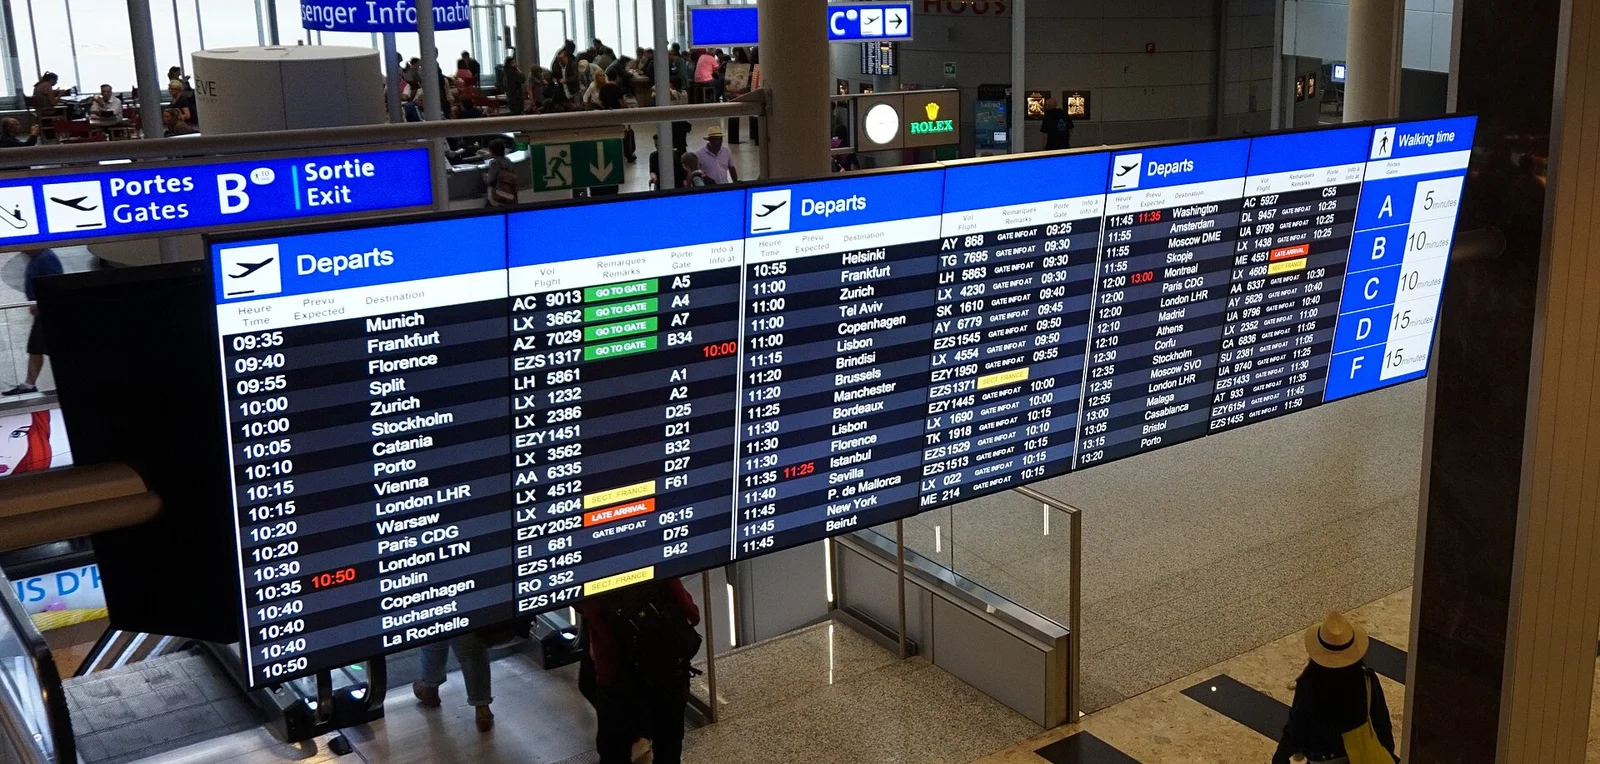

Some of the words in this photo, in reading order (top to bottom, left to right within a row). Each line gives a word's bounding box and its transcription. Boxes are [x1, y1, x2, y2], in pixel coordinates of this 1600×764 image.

[830, 11, 846, 36] C
[910, 120, 954, 134] ROLEX
[1399, 132, 1434, 146] Walking
[1436, 130, 1454, 142] time
[304, 159, 375, 181] Sortie
[1147, 159, 1193, 177] Departs
[110, 174, 194, 197] Portes
[216, 173, 250, 215] B
[307, 185, 352, 206] Exit
[801, 195, 866, 217] Departs
[1110, 214, 1133, 226] 11:45
[1139, 210, 1160, 222] 11:35
[1172, 204, 1218, 218] Washington
[1243, 197, 1256, 208] AC
[1260, 194, 1279, 205] 5927
[1322, 186, 1336, 197] C55
[1378, 195, 1392, 218] A
[1423, 190, 1434, 210] 5
[112, 200, 189, 224] Gates
[843, 232, 884, 242] Destination
[958, 223, 976, 231] Flight
[1106, 245, 1129, 257] 11:55
[1168, 236, 1200, 248] Moscow
[1201, 230, 1221, 243] DME
[1239, 226, 1251, 236] UA
[1255, 222, 1274, 234] 9799
[1316, 213, 1334, 224] 10:25
[754, 261, 786, 276] 10:55
[842, 248, 885, 264] Helsinki
[941, 237, 958, 250] AY
[964, 234, 983, 247] 868
[997, 232, 1013, 240] GATE
[1029, 228, 1037, 236] AT
[1046, 222, 1071, 235] 09:25
[794, 243, 829, 253] Expected
[1371, 236, 1386, 259] B
[1409, 230, 1426, 251] 10
[297, 248, 394, 275] Departs
[596, 258, 646, 268] Remarques
[533, 278, 560, 288] Flight
[602, 268, 640, 278] Remarks
[1401, 270, 1418, 291] 10
[365, 291, 424, 304] Destination
[1364, 277, 1379, 299] C
[238, 306, 271, 314] Heure
[751, 315, 784, 331] 11:00
[839, 304, 856, 317] Tel
[858, 301, 883, 314] Aviv
[937, 288, 952, 300] LX
[959, 283, 985, 296] 4230
[1041, 270, 1066, 284] 09:30
[233, 331, 283, 351] 09:35
[366, 312, 424, 332] Munich
[513, 296, 536, 311] AC
[546, 289, 581, 306] 9013
[596, 288, 609, 297] GO
[611, 286, 621, 294] TO
[624, 283, 646, 293] GATE
[671, 274, 690, 289] A5
[242, 318, 270, 326] Time
[293, 307, 345, 320] Expected
[1393, 309, 1411, 330] 15
[1093, 350, 1116, 363] 12:30
[1154, 337, 1176, 350] Corfu
[1224, 324, 1235, 335] LX
[1240, 320, 1258, 332] 2352
[1299, 307, 1318, 319] 11:00
[1356, 317, 1371, 340] D
[1350, 356, 1364, 378] F
[1386, 348, 1403, 368] 15
[242, 417, 289, 437] 10:00
[370, 396, 420, 416] Zurich
[515, 375, 535, 390] LH
[546, 367, 579, 384] 5861
[703, 341, 736, 357] 10:00
[745, 470, 776, 486] 11:35
[784, 462, 814, 477] 11:25
[830, 449, 871, 468] Istanbul
[926, 432, 940, 444] TK
[948, 425, 971, 439] 1918
[1027, 407, 1051, 421] 10:15
[743, 535, 773, 552] 11:45
[826, 515, 857, 531] Beirut
[920, 493, 937, 506] ME
[941, 487, 959, 500] 214
[1021, 465, 1044, 479] 10:15
[254, 561, 299, 581] 10:30
[378, 536, 417, 554] Paris
[421, 525, 458, 543] CDG
[517, 507, 536, 522] LX
[547, 497, 581, 514] 4604
[665, 474, 687, 489] F61
[256, 580, 301, 601] 10:35
[312, 568, 355, 588] 10:50
[592, 511, 611, 521] LATE
[613, 504, 646, 516] ARRIVAL
[258, 600, 302, 620] 10:40
[380, 572, 427, 592] Dublin
[518, 544, 531, 558] EI
[548, 535, 571, 551] 681
[592, 527, 614, 538] GATE
[616, 523, 634, 532] INFO
[635, 520, 646, 528] AT
[659, 507, 693, 524] 09:15
